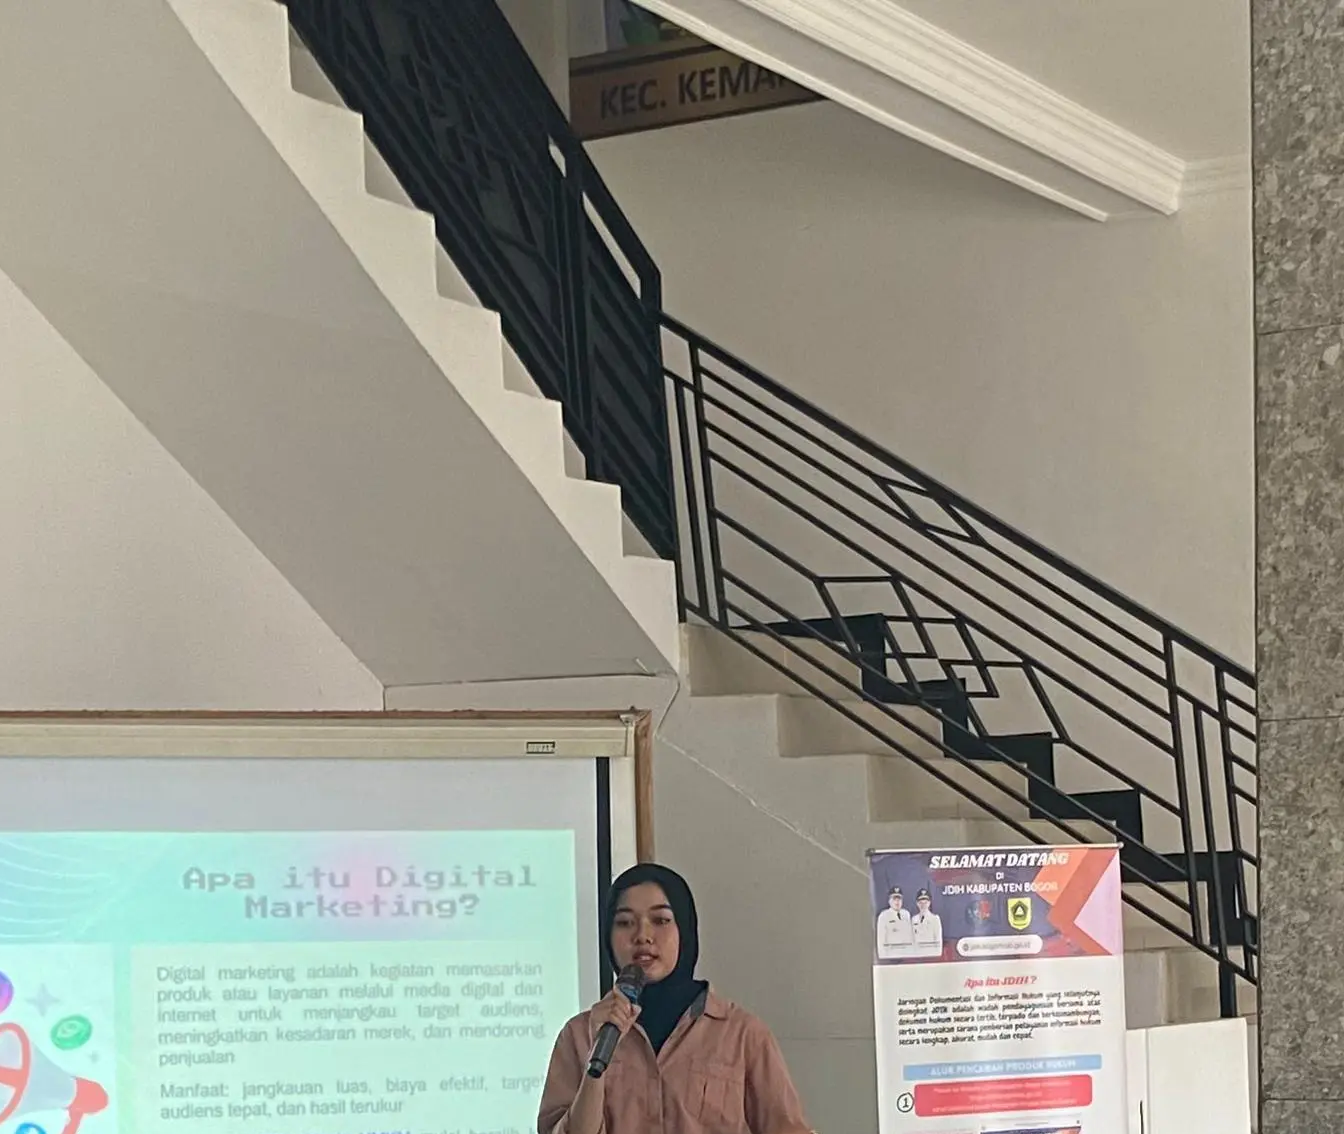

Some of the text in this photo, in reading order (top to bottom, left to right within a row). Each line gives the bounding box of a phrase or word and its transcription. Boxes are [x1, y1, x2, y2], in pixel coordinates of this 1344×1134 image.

[600, 62, 786, 120] KEC. KEMA
[929, 852, 1069, 869] SELAMAT DATANG
[182, 865, 537, 892] Apa itu Digital
[996, 872, 1004, 880] DI
[942, 882, 1058, 895] JDIH KABUPATEN BOGOR
[244, 894, 480, 919] Marketing?
[156, 962, 542, 984] Digital marketing adalah kegiatan memasarkan
[157, 981, 543, 1003] produk atau layanan melalui media digital dan
[238, 1006, 282, 1021] untuk
[304, 1004, 397, 1023] menjangkau
[417, 1004, 460, 1020] target
[158, 1023, 545, 1047] meningkatkan kesadaran merek, dan mendorong
[159, 1051, 235, 1068] penjualan
[160, 1082, 229, 1098] Manfaat:
[243, 1080, 323, 1100] jangkauan
[336, 1079, 372, 1096] luas,
[386, 1078, 427, 1096] biaya
[160, 1098, 404, 1120] audiens tepat, dan hasil terukur
